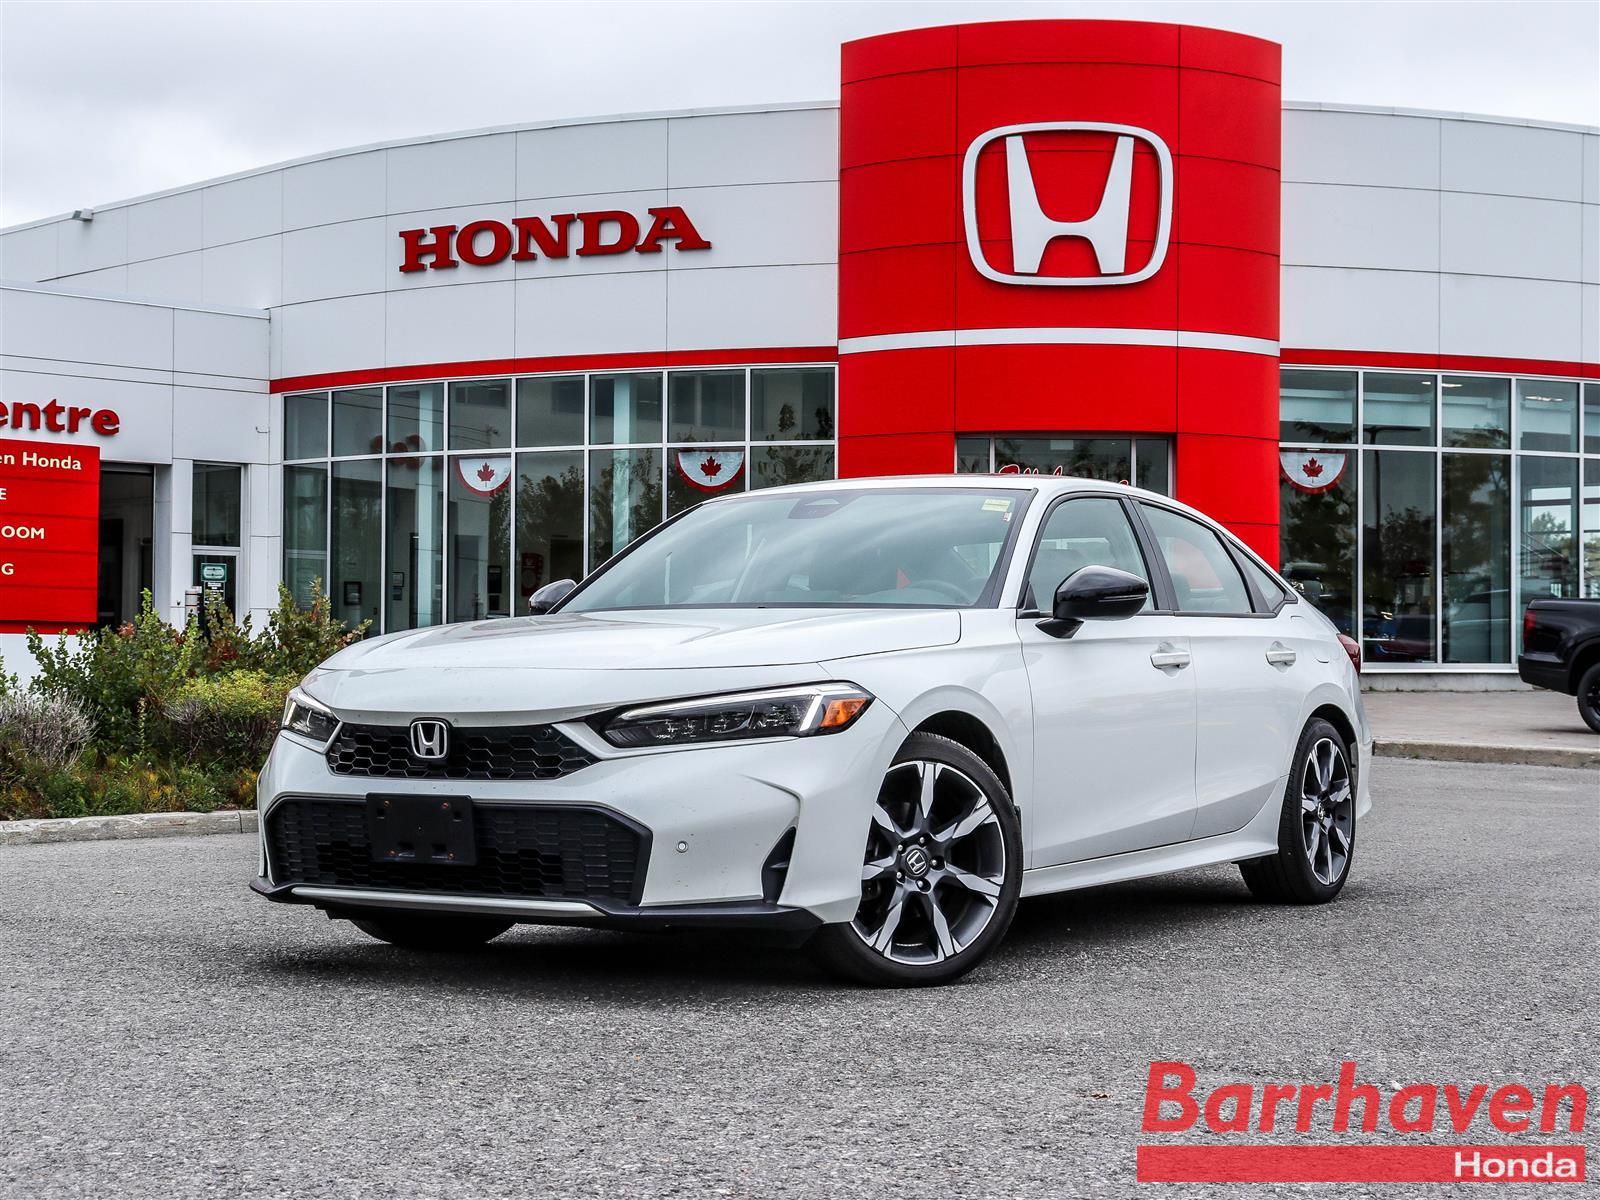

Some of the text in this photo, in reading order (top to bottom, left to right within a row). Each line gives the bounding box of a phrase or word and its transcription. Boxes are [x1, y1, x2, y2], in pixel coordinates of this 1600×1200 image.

[399, 206, 712, 273] HONDA
[0, 451, 82, 470] n Honda
